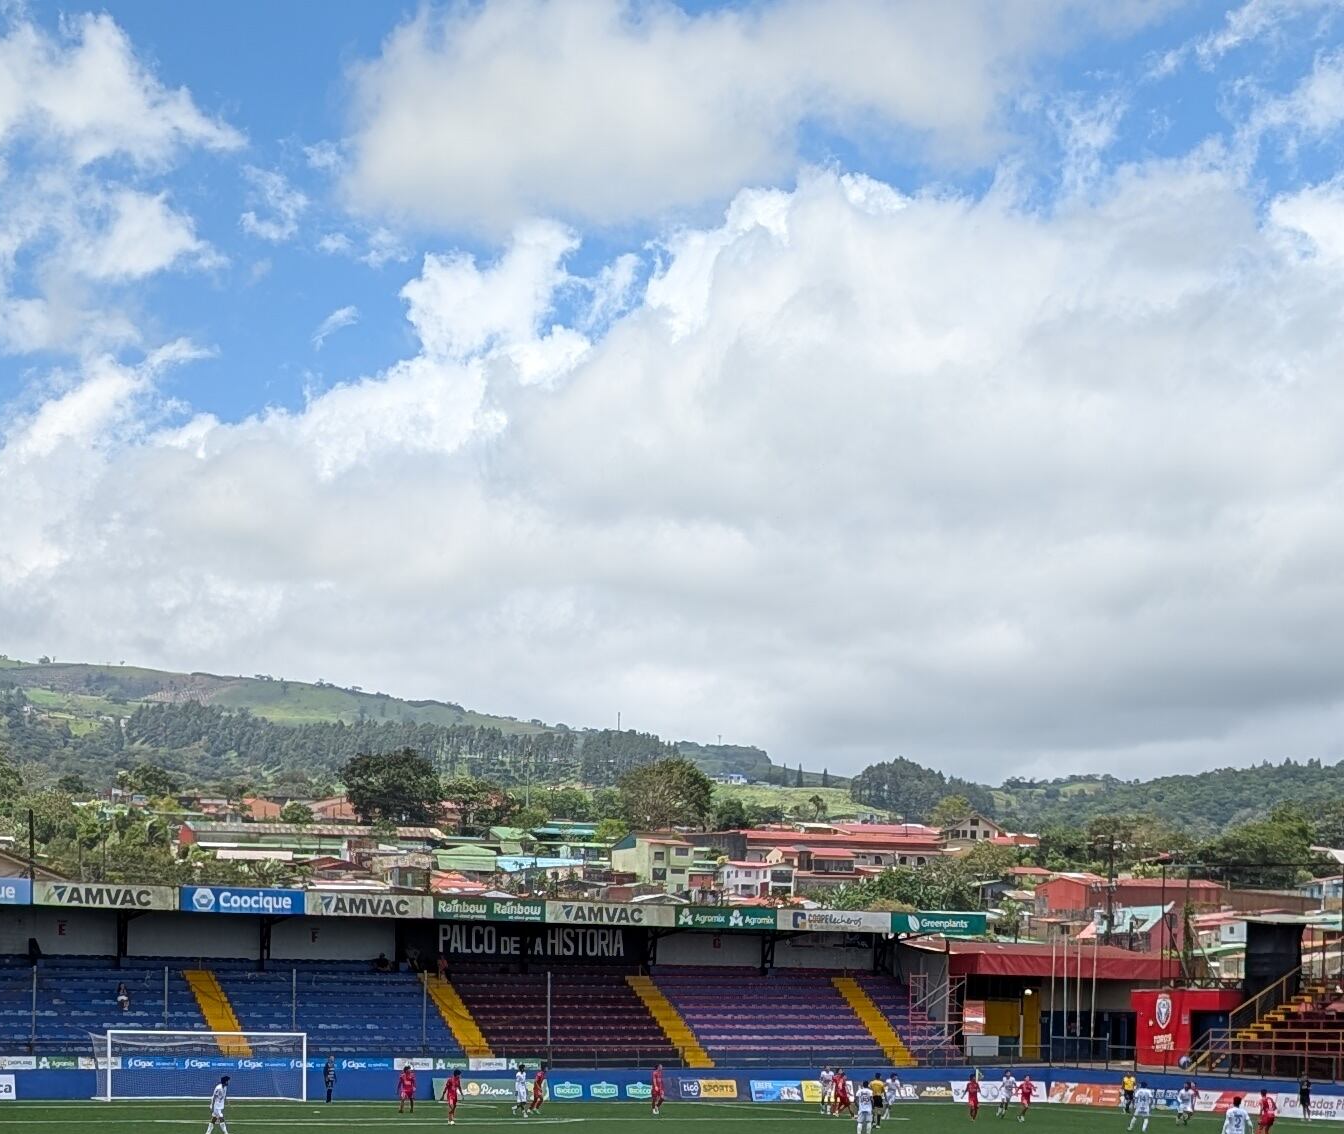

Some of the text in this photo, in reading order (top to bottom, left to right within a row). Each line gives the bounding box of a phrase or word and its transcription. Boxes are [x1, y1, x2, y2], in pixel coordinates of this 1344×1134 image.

[68, 886, 152, 907] AMVAC
[218, 891, 292, 912] Coocique
[333, 897, 410, 916] AMVAC
[438, 899, 487, 915] Rainbow
[493, 902, 542, 916] Rainbow
[573, 905, 644, 924] AMVAC
[694, 912, 726, 925] Agromix
[744, 914, 775, 926] Agromix
[920, 917, 969, 929] Greenplants
[438, 924, 496, 954] PALCO
[500, 936, 521, 955] DE
[547, 927, 625, 957] HISTORIA
[133, 1058, 154, 1069] Cigac
[189, 1059, 211, 1069] Cigac
[243, 1059, 264, 1069] Cigac
[347, 1060, 367, 1070] Cigac
[480, 1083, 513, 1097] Pinos
[702, 1084, 735, 1093] SPORTS
